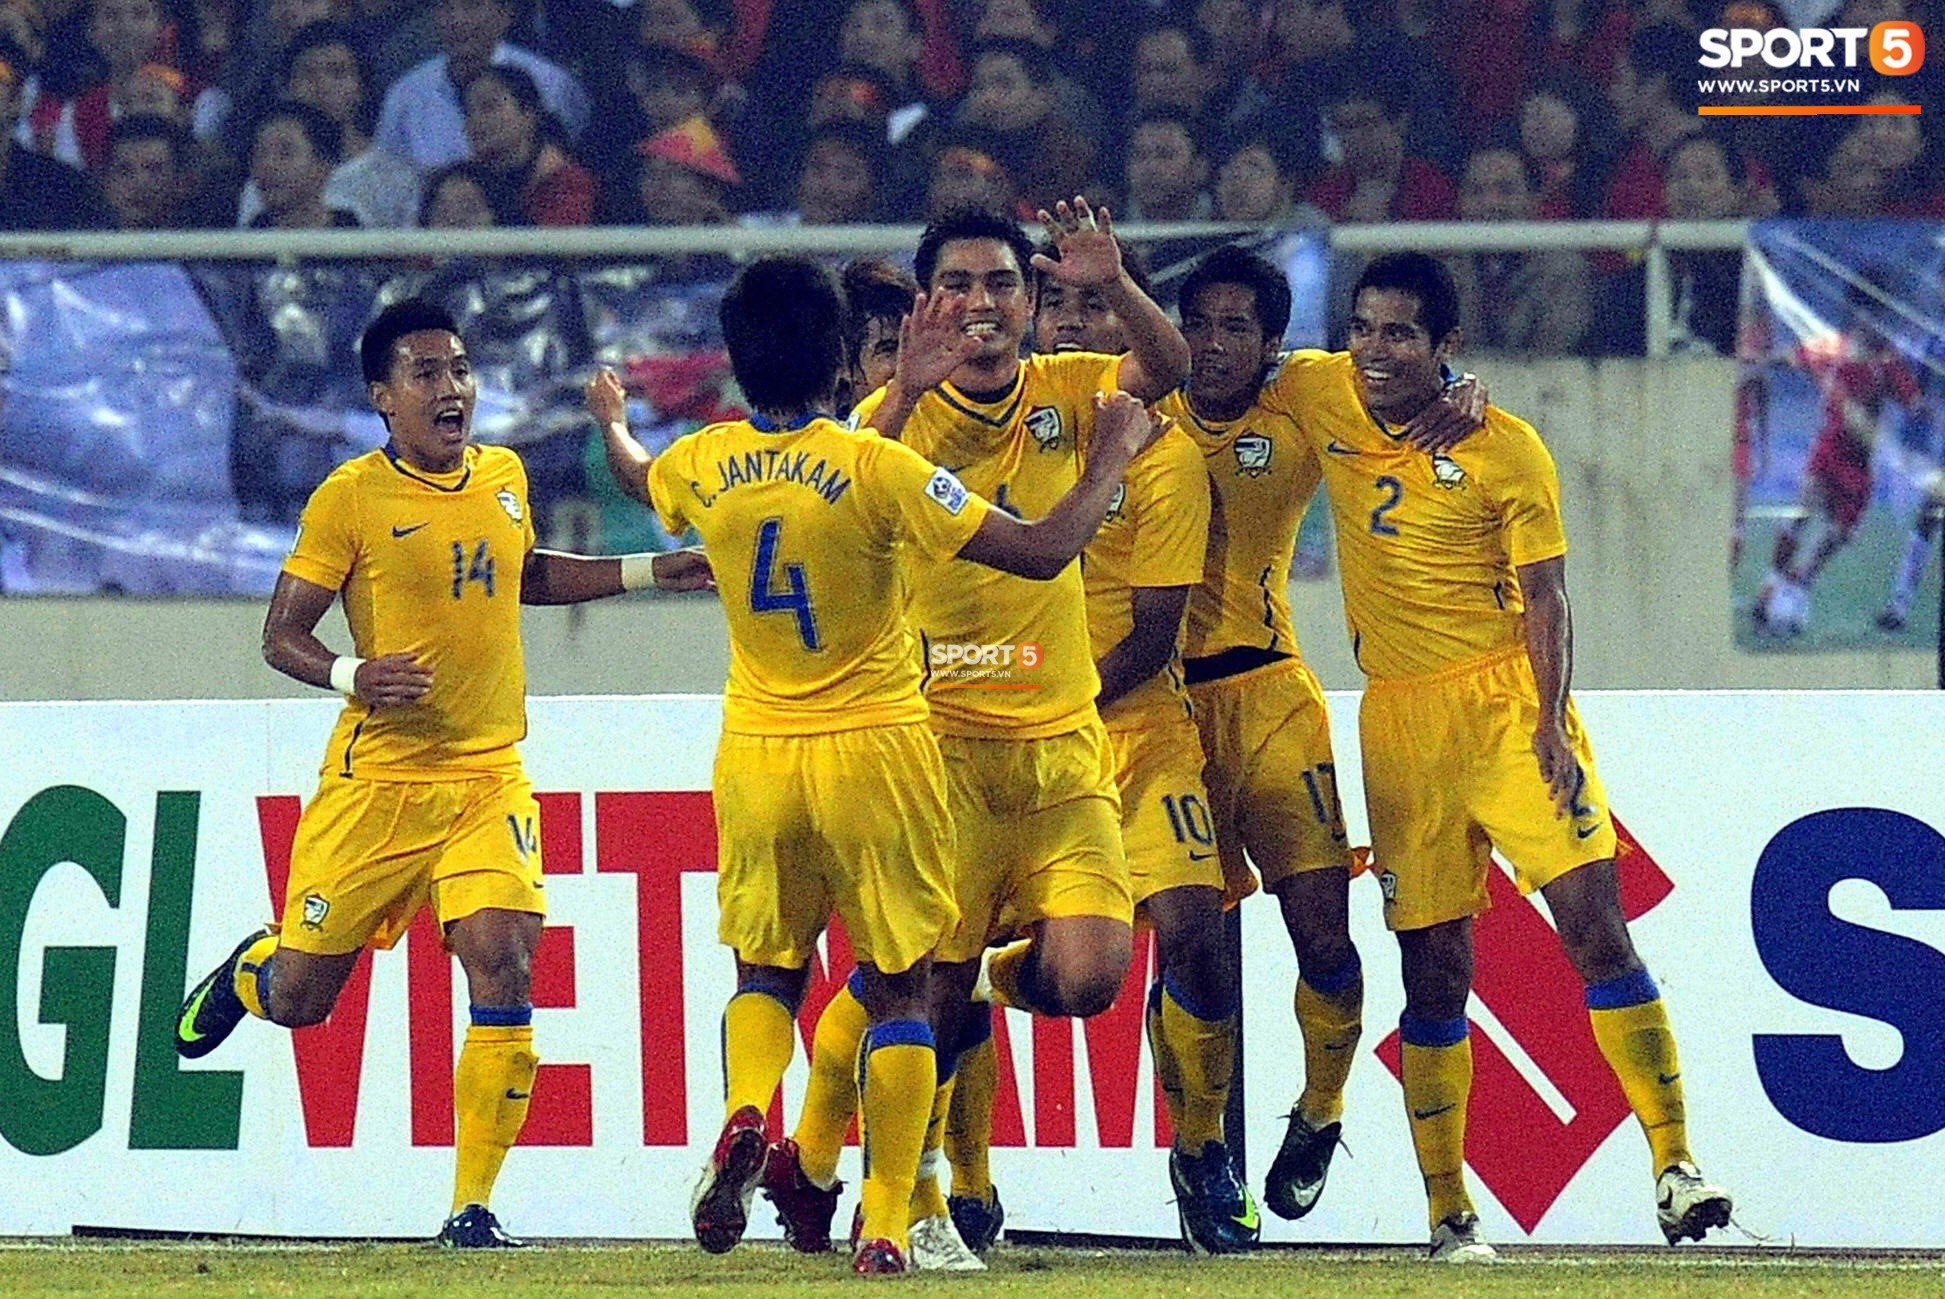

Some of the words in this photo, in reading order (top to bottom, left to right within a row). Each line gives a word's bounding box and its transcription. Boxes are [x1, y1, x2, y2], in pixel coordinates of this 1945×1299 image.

[1371, 475, 1403, 536] 2
[451, 539, 495, 600] 14
[749, 517, 821, 652] 4
[1162, 794, 1213, 846] 10
